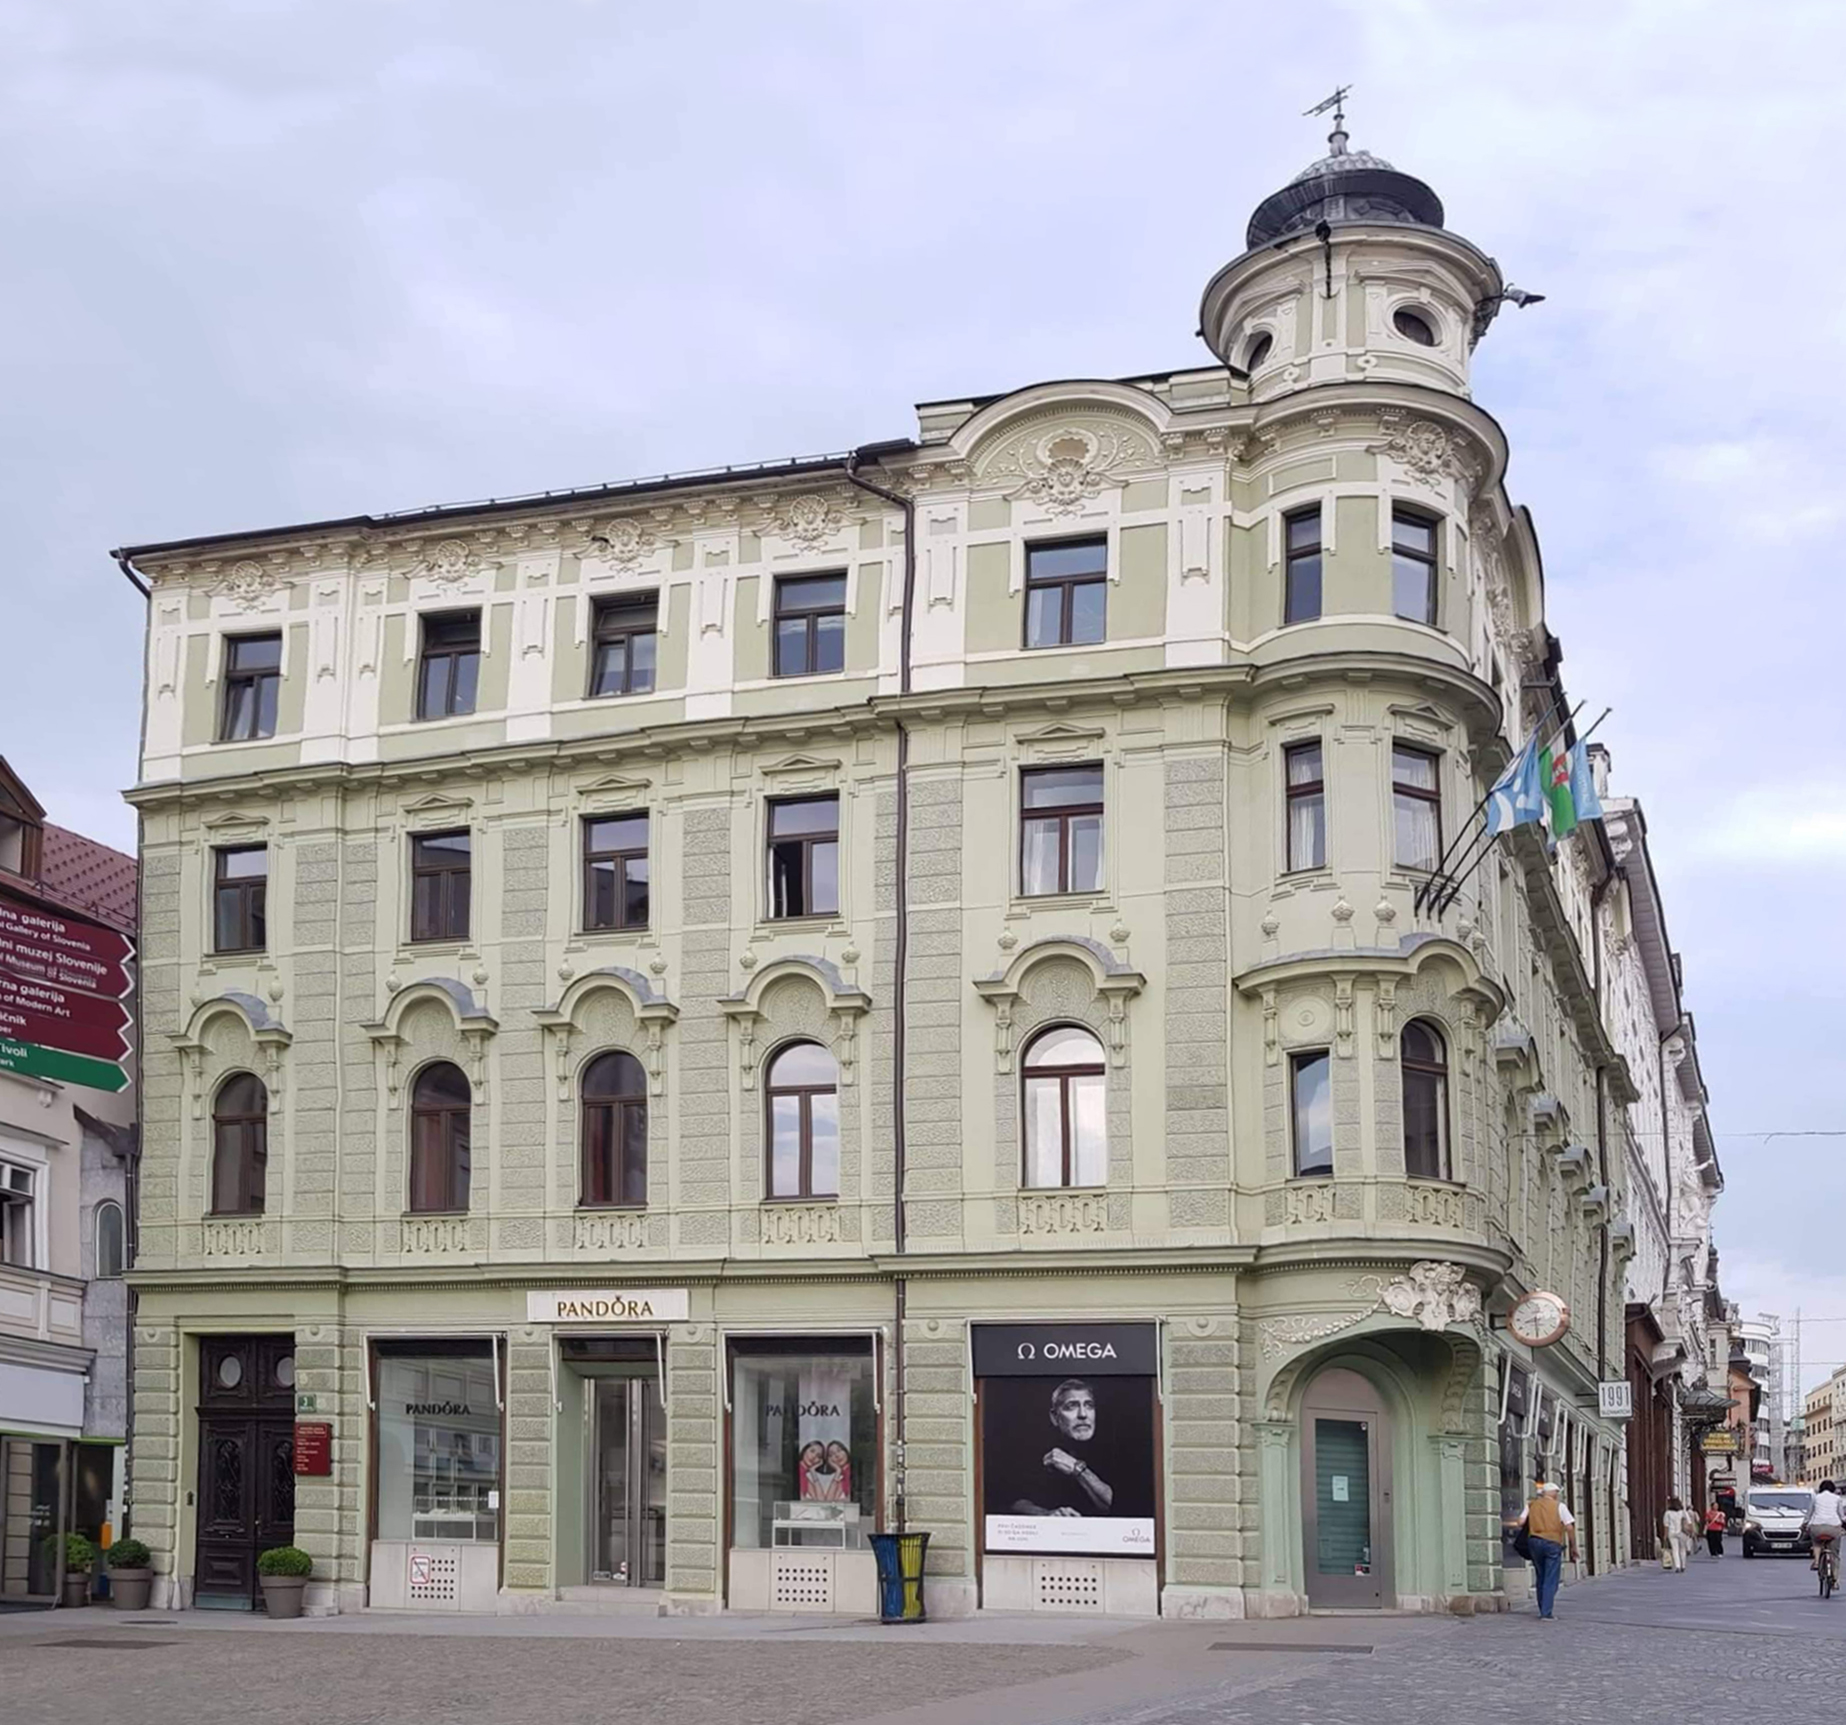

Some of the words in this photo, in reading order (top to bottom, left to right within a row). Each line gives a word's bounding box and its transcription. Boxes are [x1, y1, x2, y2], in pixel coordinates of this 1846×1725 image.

[22, 914, 65, 934] galerija
[6, 921, 39, 939] Gallery
[41, 931, 51, 941] of
[53, 933, 91, 951] Slovenia
[16, 944, 53, 962] muzej
[56, 951, 108, 976] Slovenije
[6, 955, 45, 973] Museum
[59, 970, 97, 989] Slovenia
[20, 983, 65, 1004] galerija
[4, 995, 15, 1004] of
[16, 997, 52, 1013] Modern
[54, 1005, 71, 1018] Art
[557, 1295, 653, 1317] PANDORA
[1043, 1343, 1118, 1360] OMEGA
[1601, 1386, 1630, 1407] 1991
[406, 1401, 471, 1416] PANDORA
[1122, 1535, 1151, 1544] OMEGA
